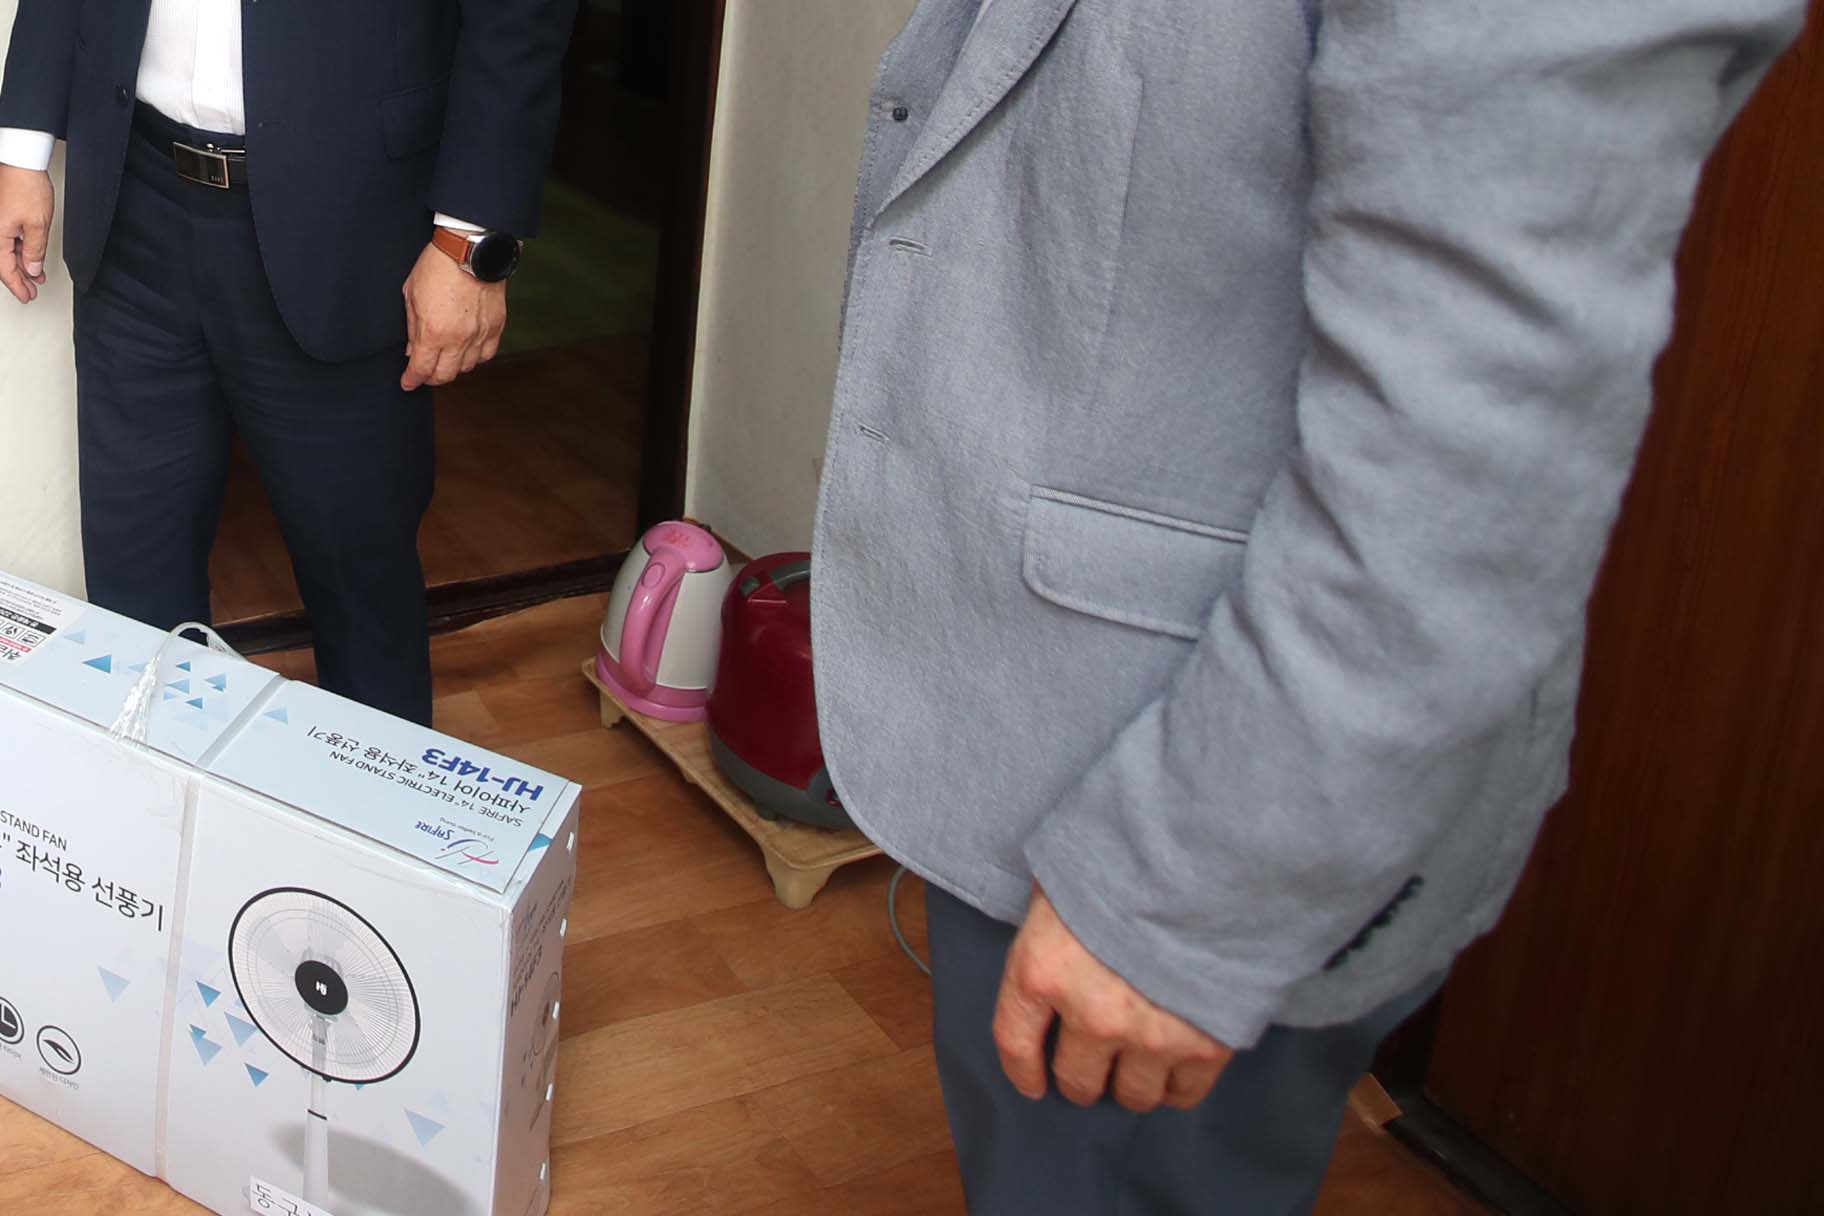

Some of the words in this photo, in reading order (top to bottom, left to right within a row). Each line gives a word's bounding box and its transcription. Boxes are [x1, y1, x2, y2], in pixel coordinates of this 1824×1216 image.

[307, 726, 360, 753] 선풍기
[329, 750, 356, 765] FAN
[355, 760, 397, 781] STAND
[363, 746, 418, 774] 좌석용
[417, 770, 447, 785] 14"
[421, 748, 544, 802] HJ-14F3
[396, 776, 455, 803] ELECTRIC
[454, 780, 531, 814] 사파이어
[478, 806, 523, 827] SAFIRE
[0, 810, 40, 838] STAND
[42, 830, 68, 852] FAN
[16, 840, 86, 893] 좌석용
[92, 877, 163, 932] 선풍기
[252, 1183, 312, 1216] 동구
